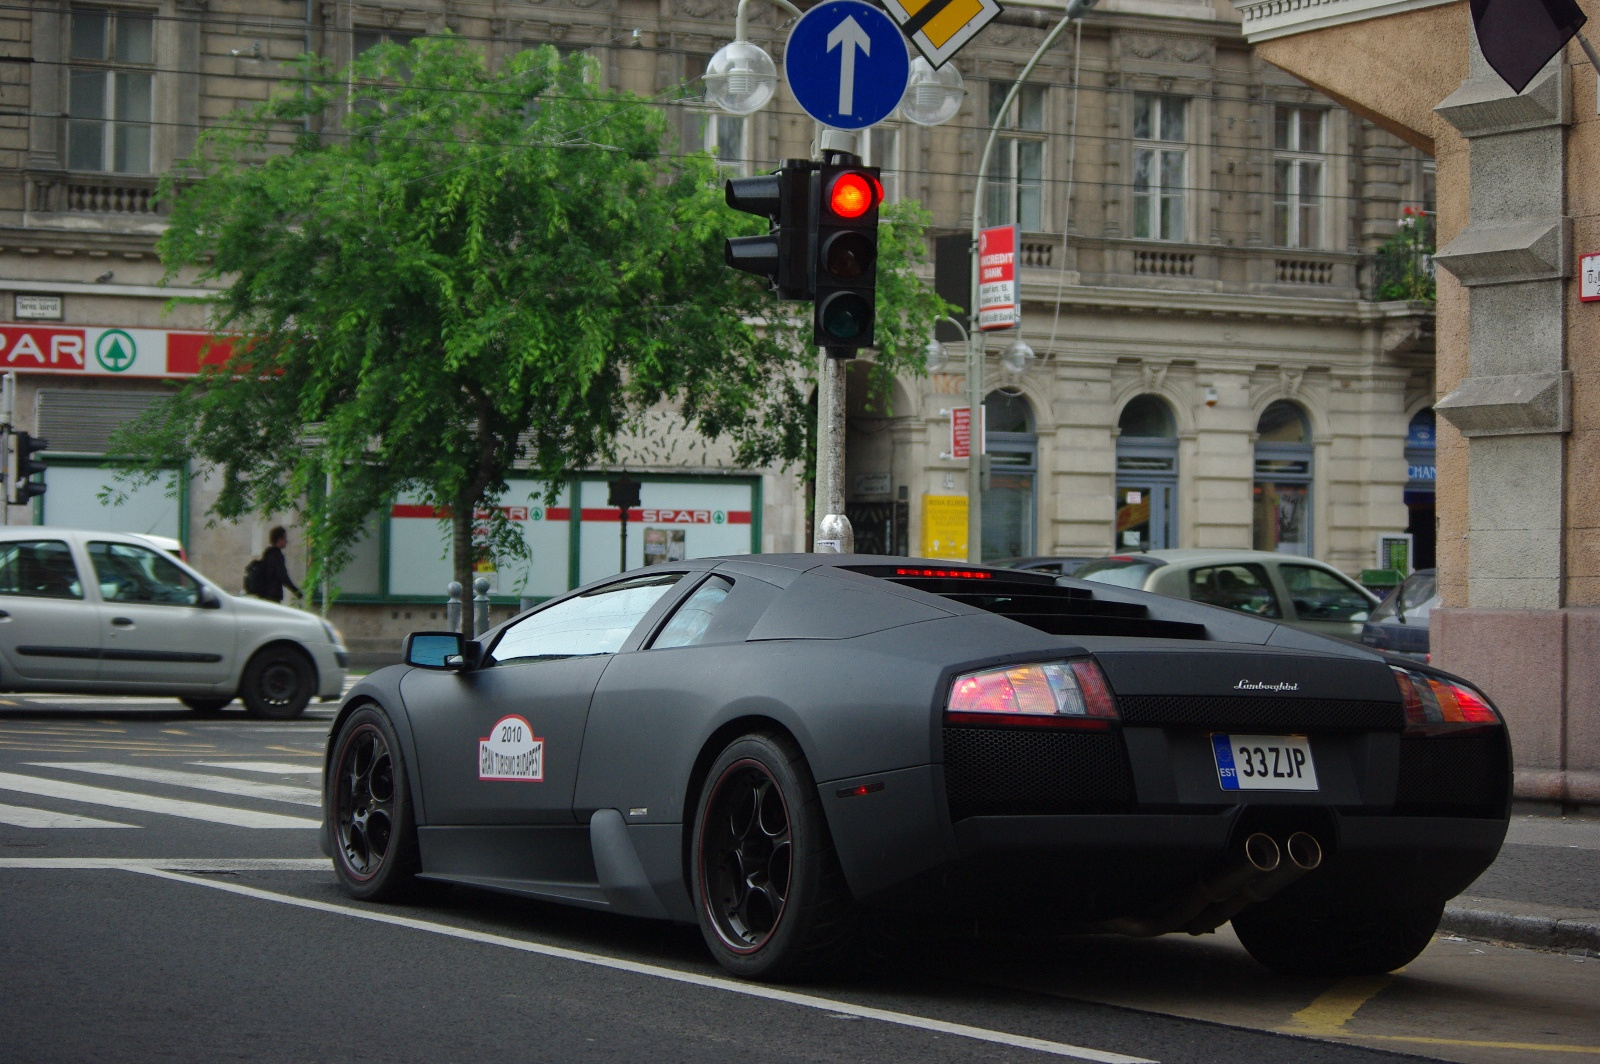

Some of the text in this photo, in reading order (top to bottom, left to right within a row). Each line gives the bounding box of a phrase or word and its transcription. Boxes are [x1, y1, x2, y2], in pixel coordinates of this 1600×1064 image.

[984, 267, 1003, 279] BANK
[642, 510, 710, 524] SPAR
[1234, 679, 1299, 692] Lamborghini
[502, 726, 522, 743] 2010
[482, 744, 542, 777] GRAN TURISMO BUDAPEST
[1239, 747, 1305, 779] 33ZJP
[1220, 768, 1236, 777] EST
